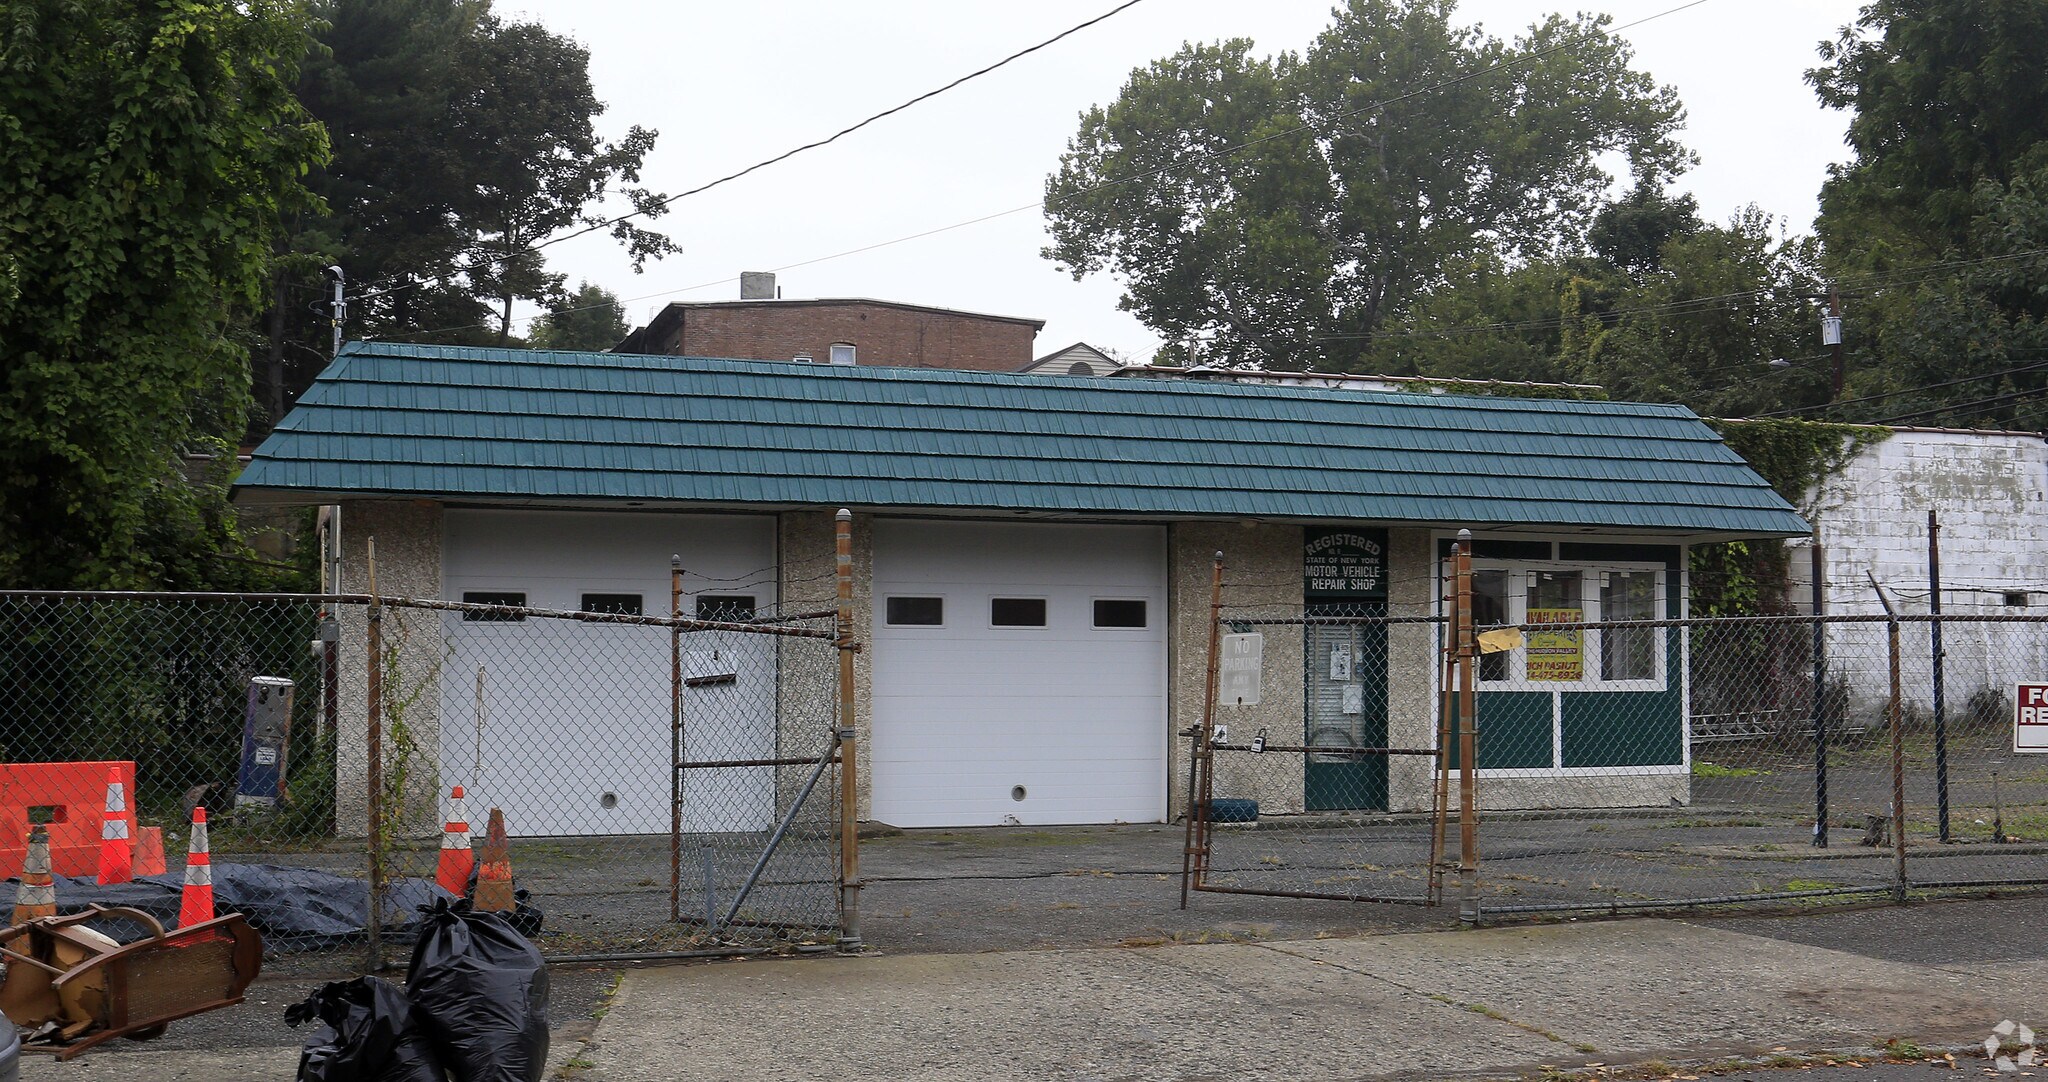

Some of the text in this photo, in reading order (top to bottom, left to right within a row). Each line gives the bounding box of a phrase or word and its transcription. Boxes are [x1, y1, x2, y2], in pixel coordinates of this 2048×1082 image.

[1305, 534, 1380, 555] REGISTERED
[1305, 565, 1380, 578] MOTOR VEHICLE
[1312, 578, 1376, 590] REPAIR SHOP
[1234, 640, 1250, 654] NO
[1224, 657, 1259, 671] PARKING
